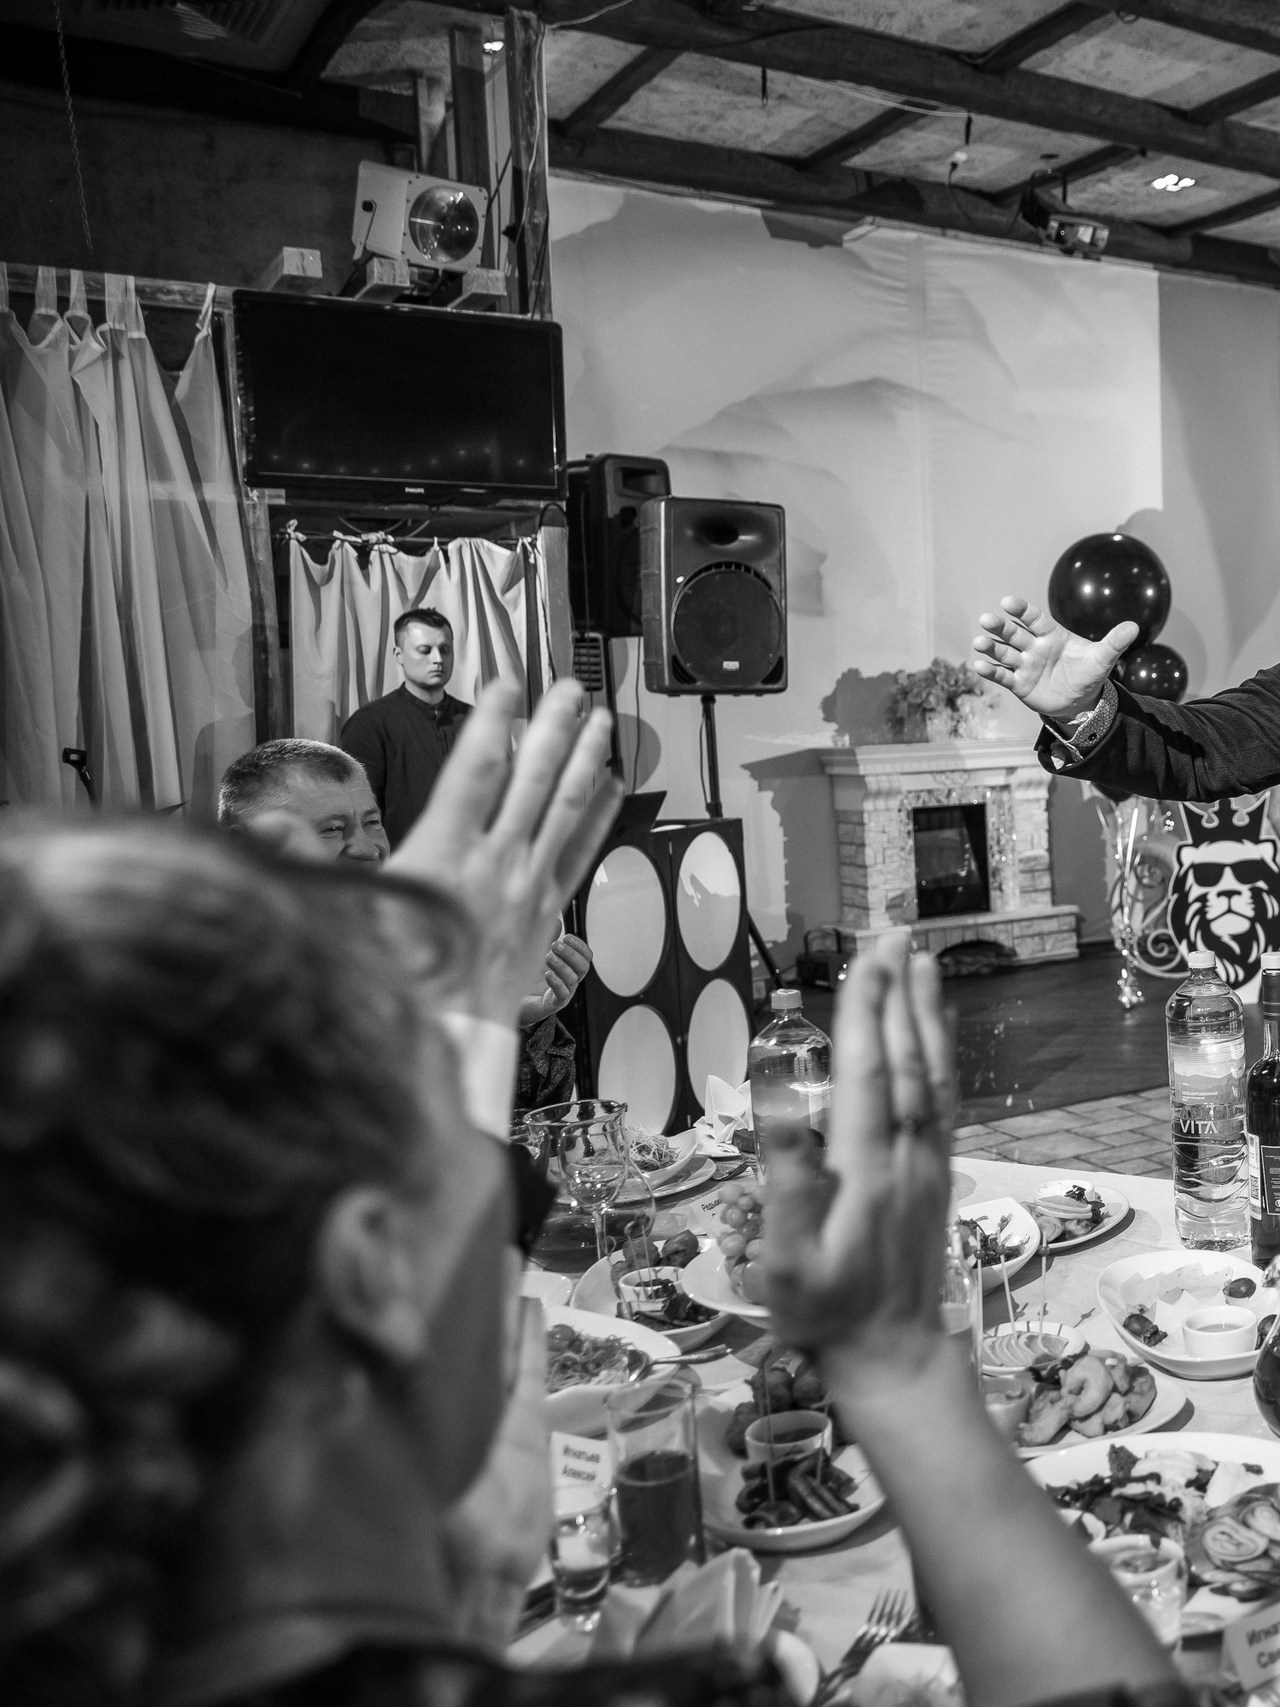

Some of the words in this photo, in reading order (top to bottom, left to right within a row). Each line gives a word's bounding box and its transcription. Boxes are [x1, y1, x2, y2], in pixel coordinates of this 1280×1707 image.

[1179, 1119, 1218, 1134] VITA
[562, 1444, 601, 1464] Игнатьев
[561, 1464, 597, 1482] Алексей
